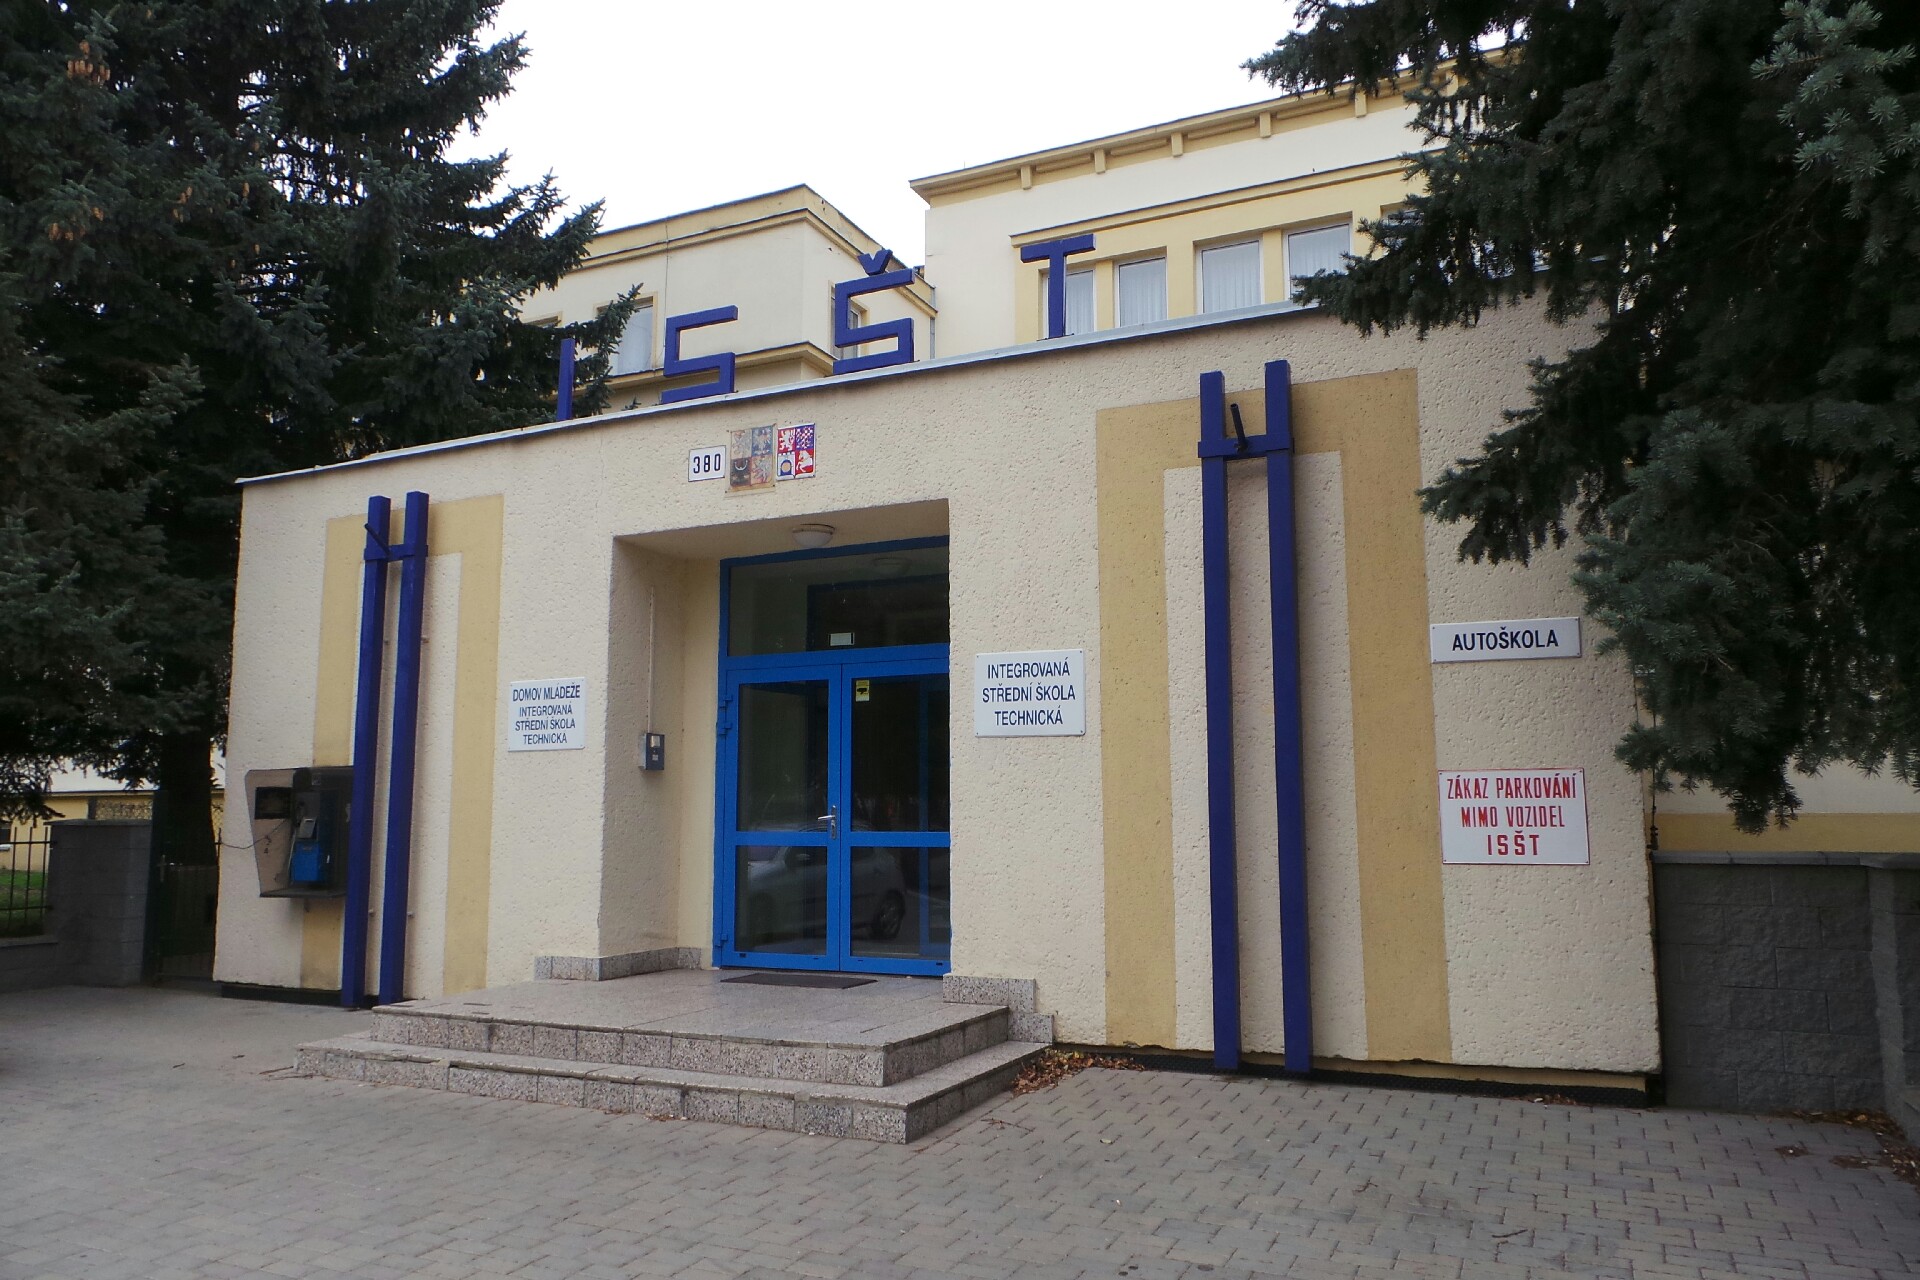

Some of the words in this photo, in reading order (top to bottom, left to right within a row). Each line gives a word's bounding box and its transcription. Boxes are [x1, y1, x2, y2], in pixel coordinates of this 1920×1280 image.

[556, 233, 1097, 421] ISŠT
[693, 453, 721, 474] 380
[1452, 626, 1559, 651] AUTOŠKOLA
[987, 656, 1071, 679] INTEGROVANÁ
[512, 687, 542, 702] DOMOV
[543, 681, 581, 700] MLÁDEŽE
[982, 682, 1033, 703] STŘEDNÍ
[1035, 682, 1076, 701] ŠKOLA
[519, 700, 573, 718] INTEGROVANÁ
[994, 705, 1064, 726] TECHNICKÁ
[515, 716, 549, 732] STŘEDNÍ
[549, 716, 576, 730] ŠKOLA
[1447, 775, 1489, 800] ZÁKAZ
[1496, 773, 1577, 799] PARKOVÁNÍ
[1461, 806, 1498, 828] MIMO
[1505, 805, 1566, 828] VOZIDEL
[1487, 830, 1540, 856] ISŠT
